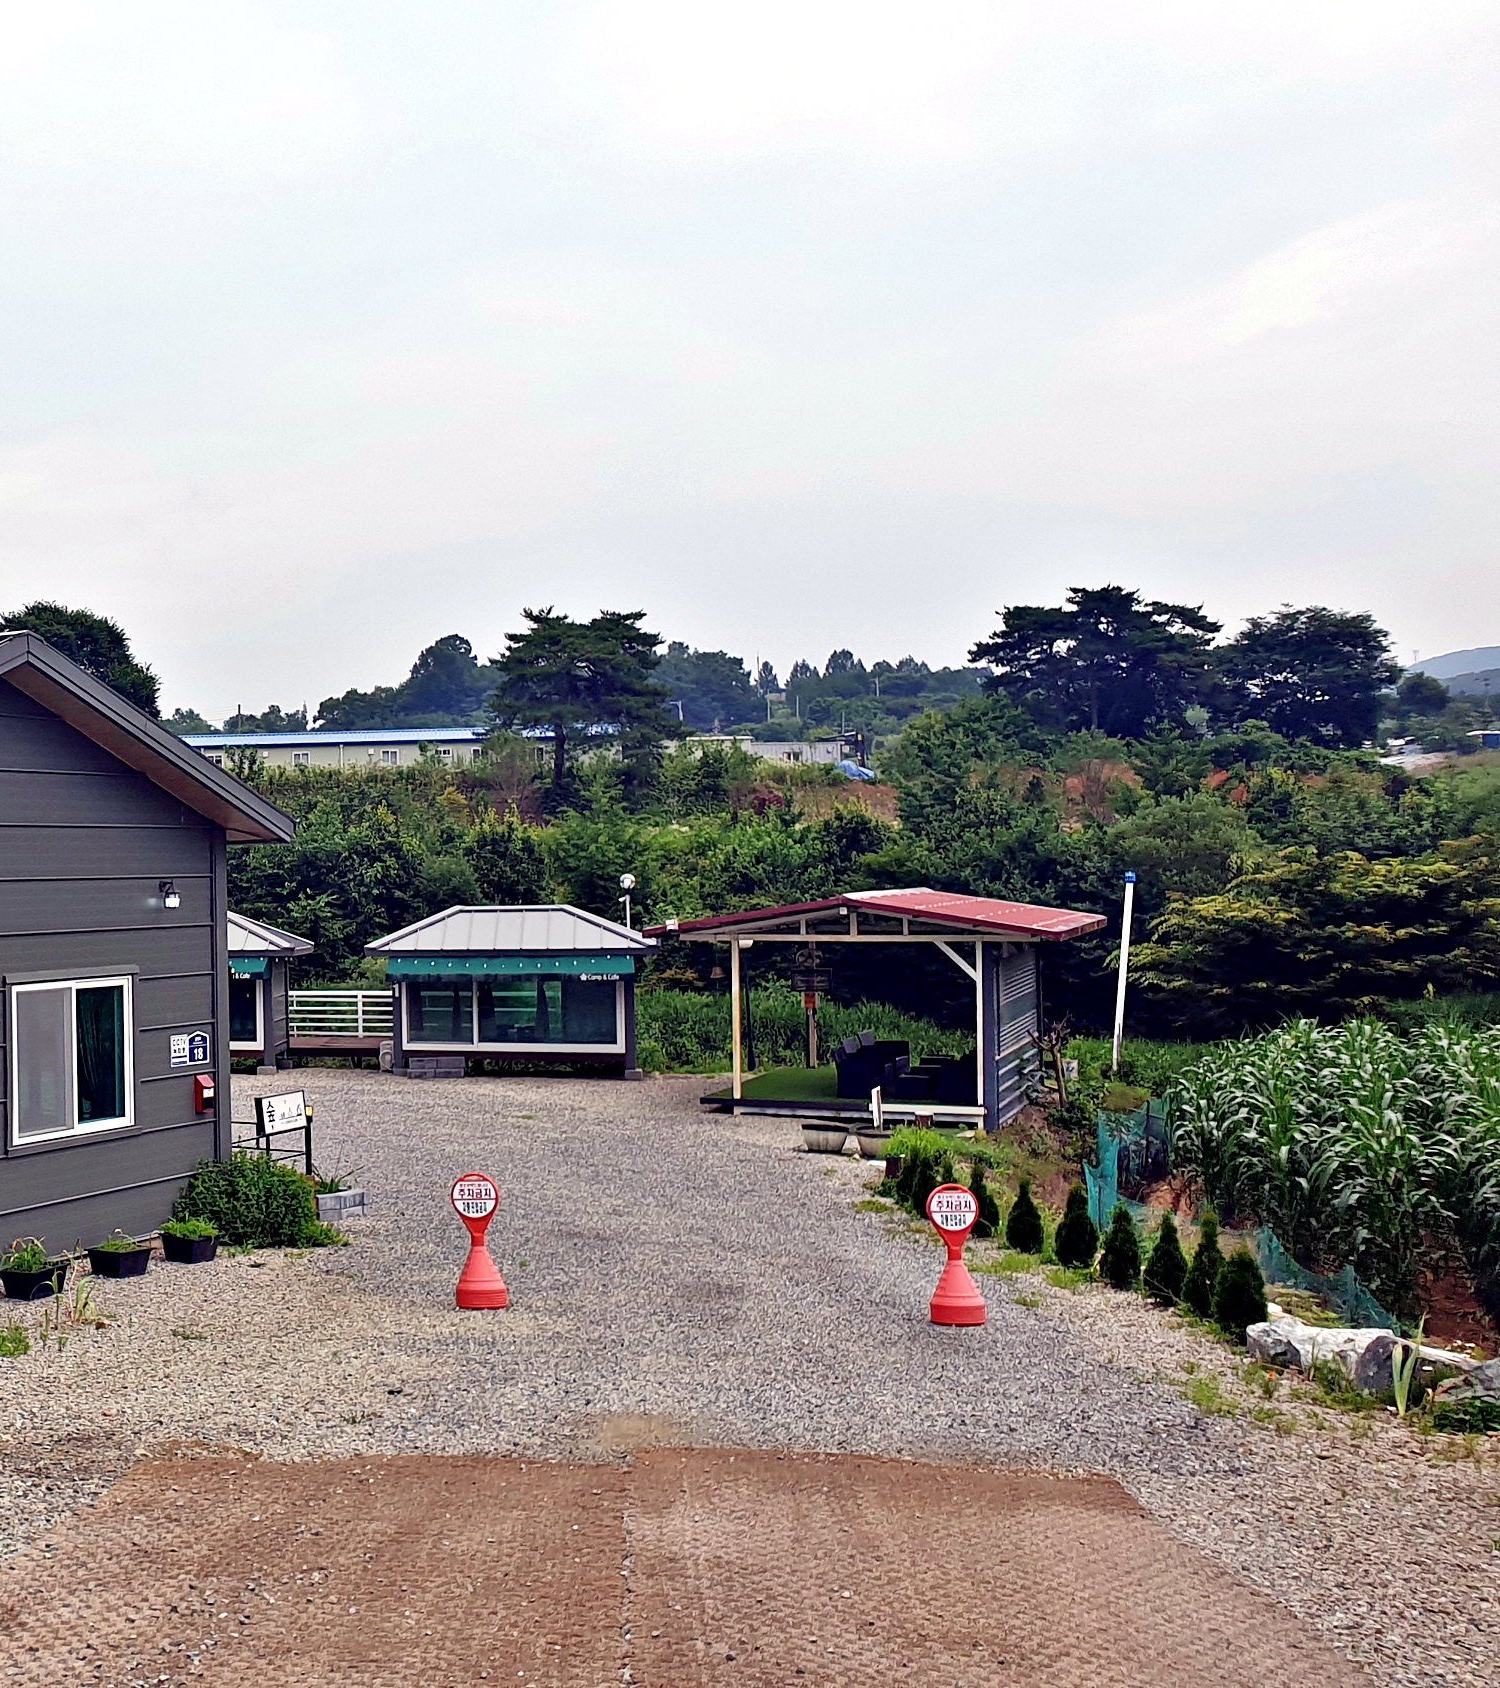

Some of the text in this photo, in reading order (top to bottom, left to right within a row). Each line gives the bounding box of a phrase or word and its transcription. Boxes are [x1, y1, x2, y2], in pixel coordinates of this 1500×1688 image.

[587, 973, 620, 981] Camp & Cafe
[172, 1038, 187, 1047] CCTV
[193, 1047, 204, 1061] 18
